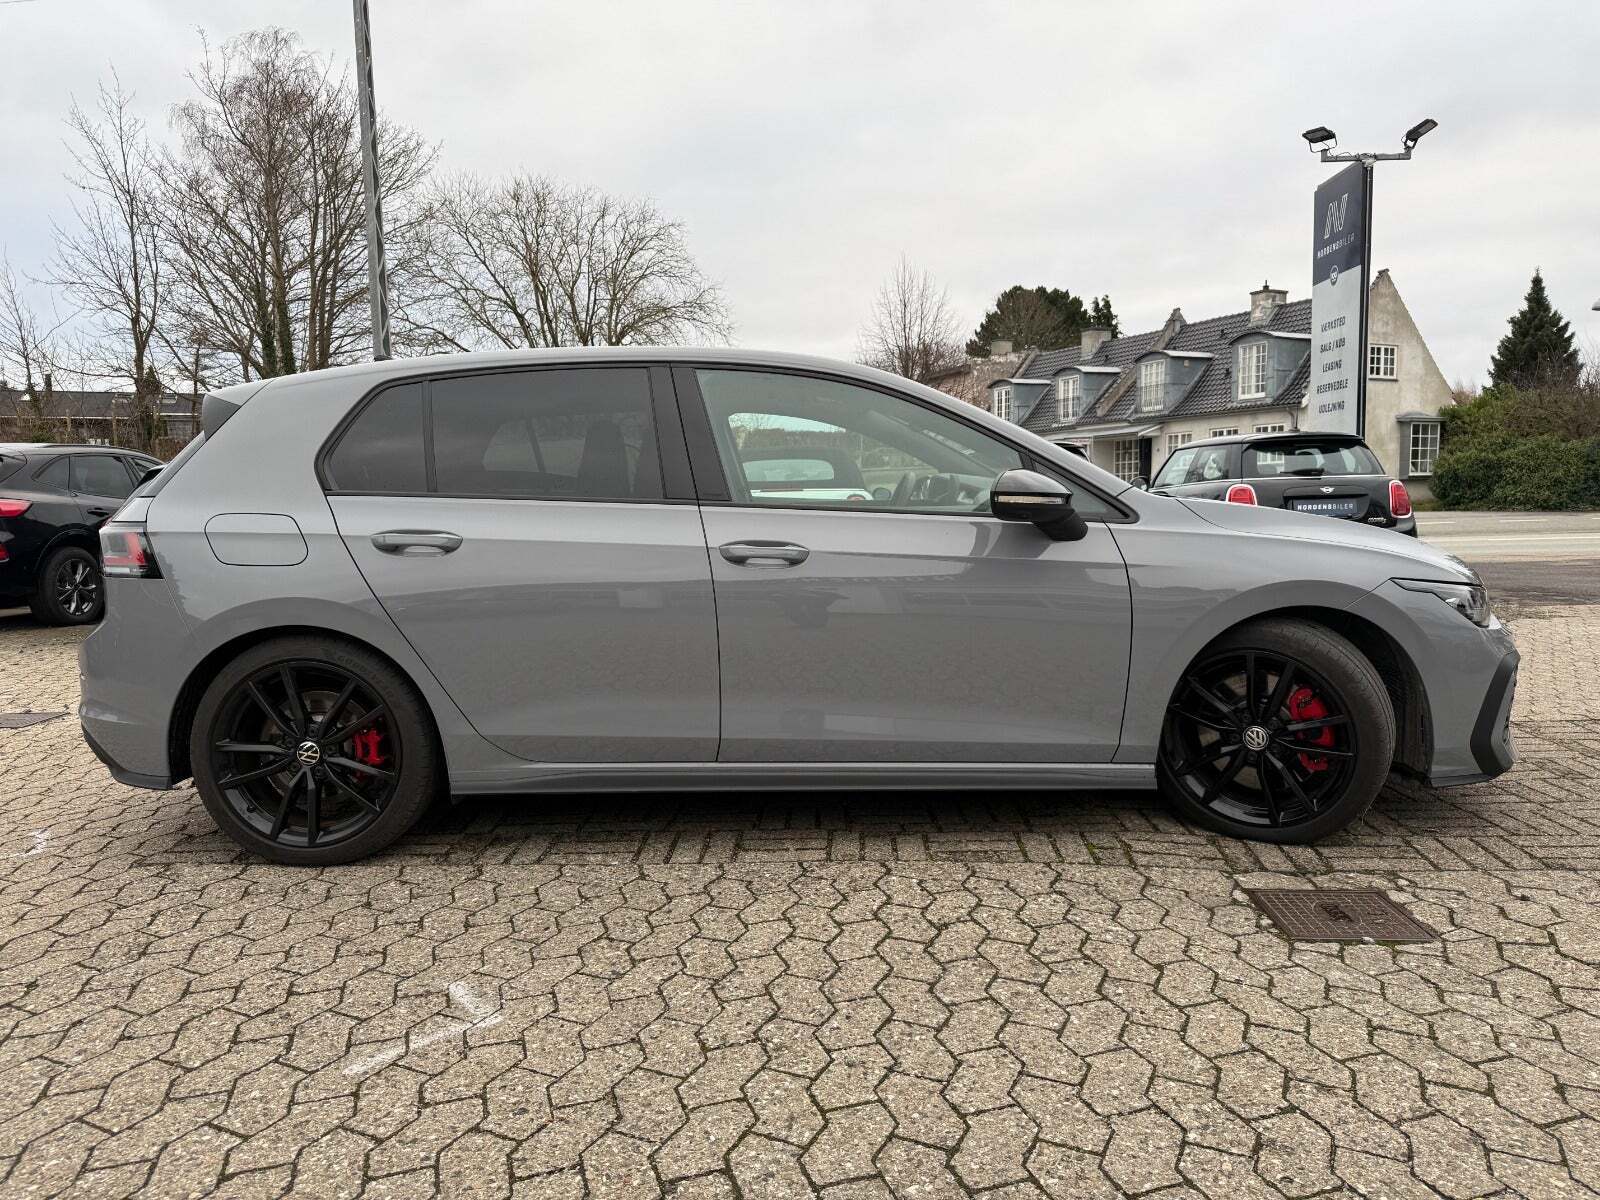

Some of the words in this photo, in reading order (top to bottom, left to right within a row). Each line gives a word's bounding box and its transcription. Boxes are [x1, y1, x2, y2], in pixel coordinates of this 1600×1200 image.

[1320, 341, 1332, 353] SALG
[1322, 360, 1342, 373] LEASING
[1316, 379, 1349, 394] RESERVEDELE
[1297, 503, 1353, 511] NORDENSBILER
